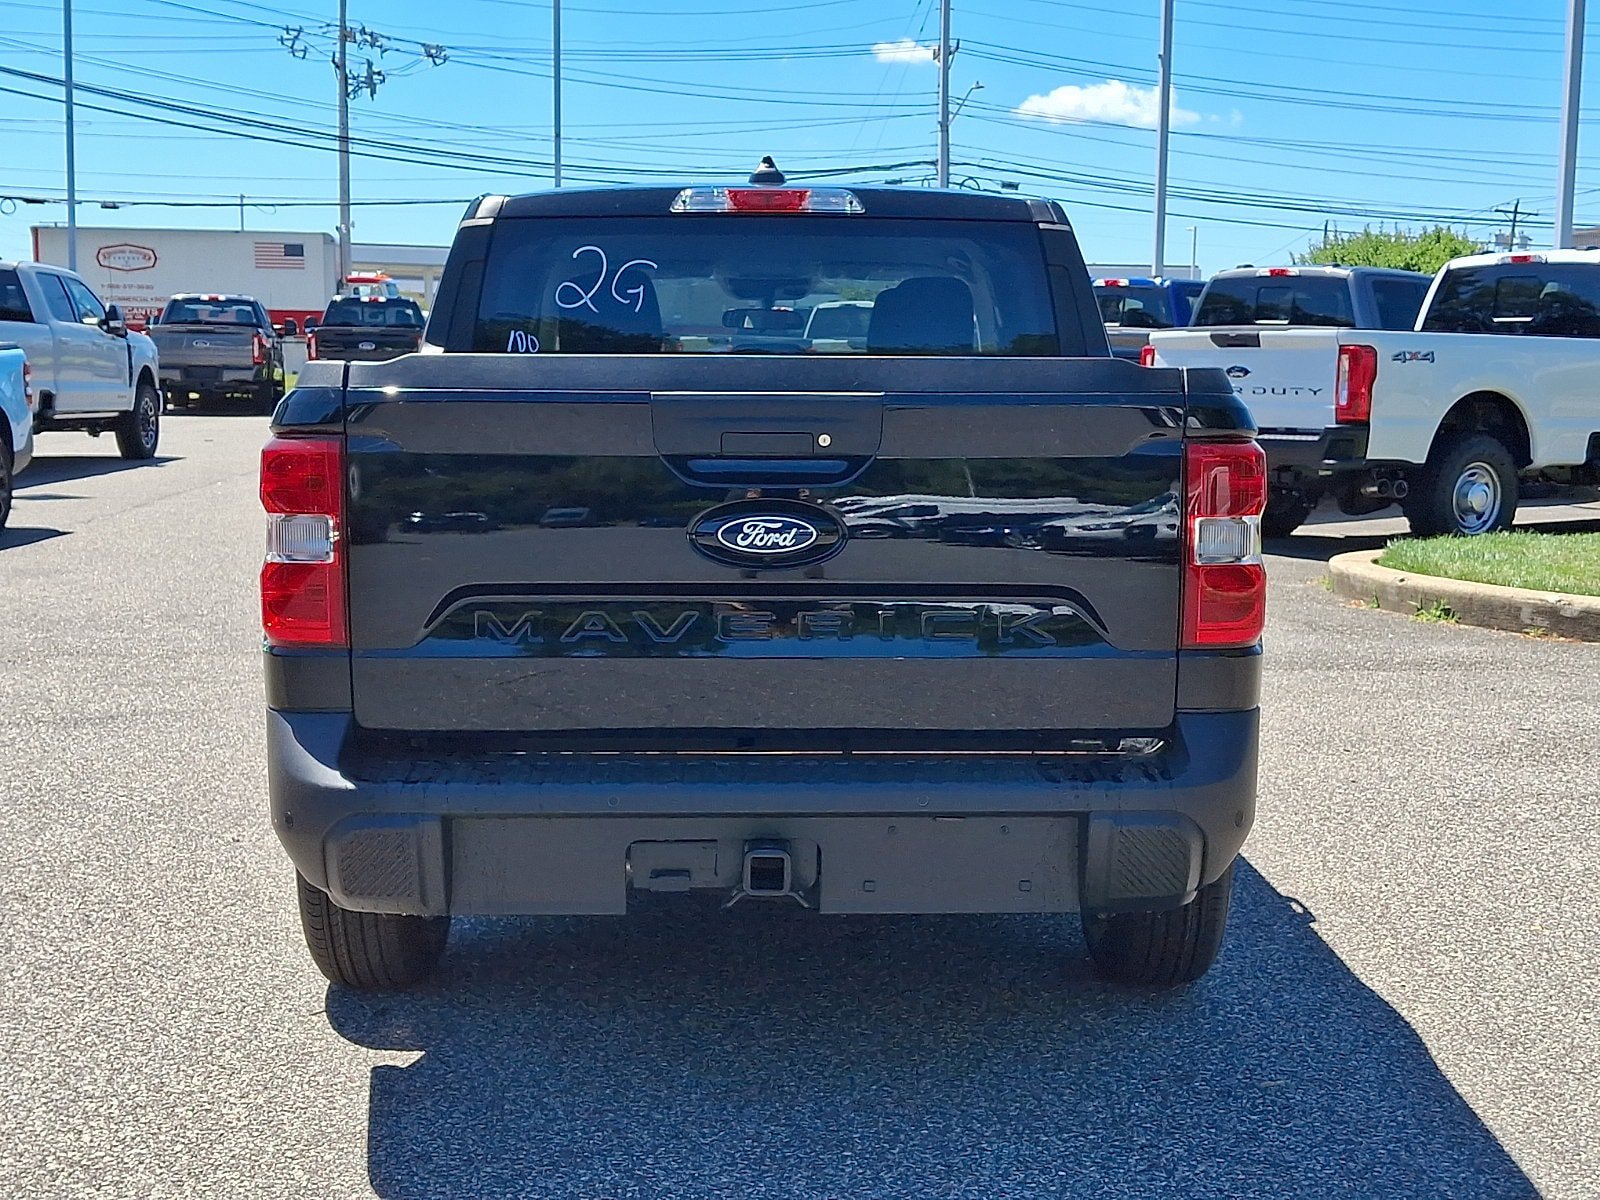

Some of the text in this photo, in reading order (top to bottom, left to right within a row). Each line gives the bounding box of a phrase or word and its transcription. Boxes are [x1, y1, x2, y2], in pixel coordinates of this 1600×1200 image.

[1252, 386, 1323, 396] DUTY
[736, 521, 798, 547] Ford
[474, 610, 1057, 644] MAVERICK
